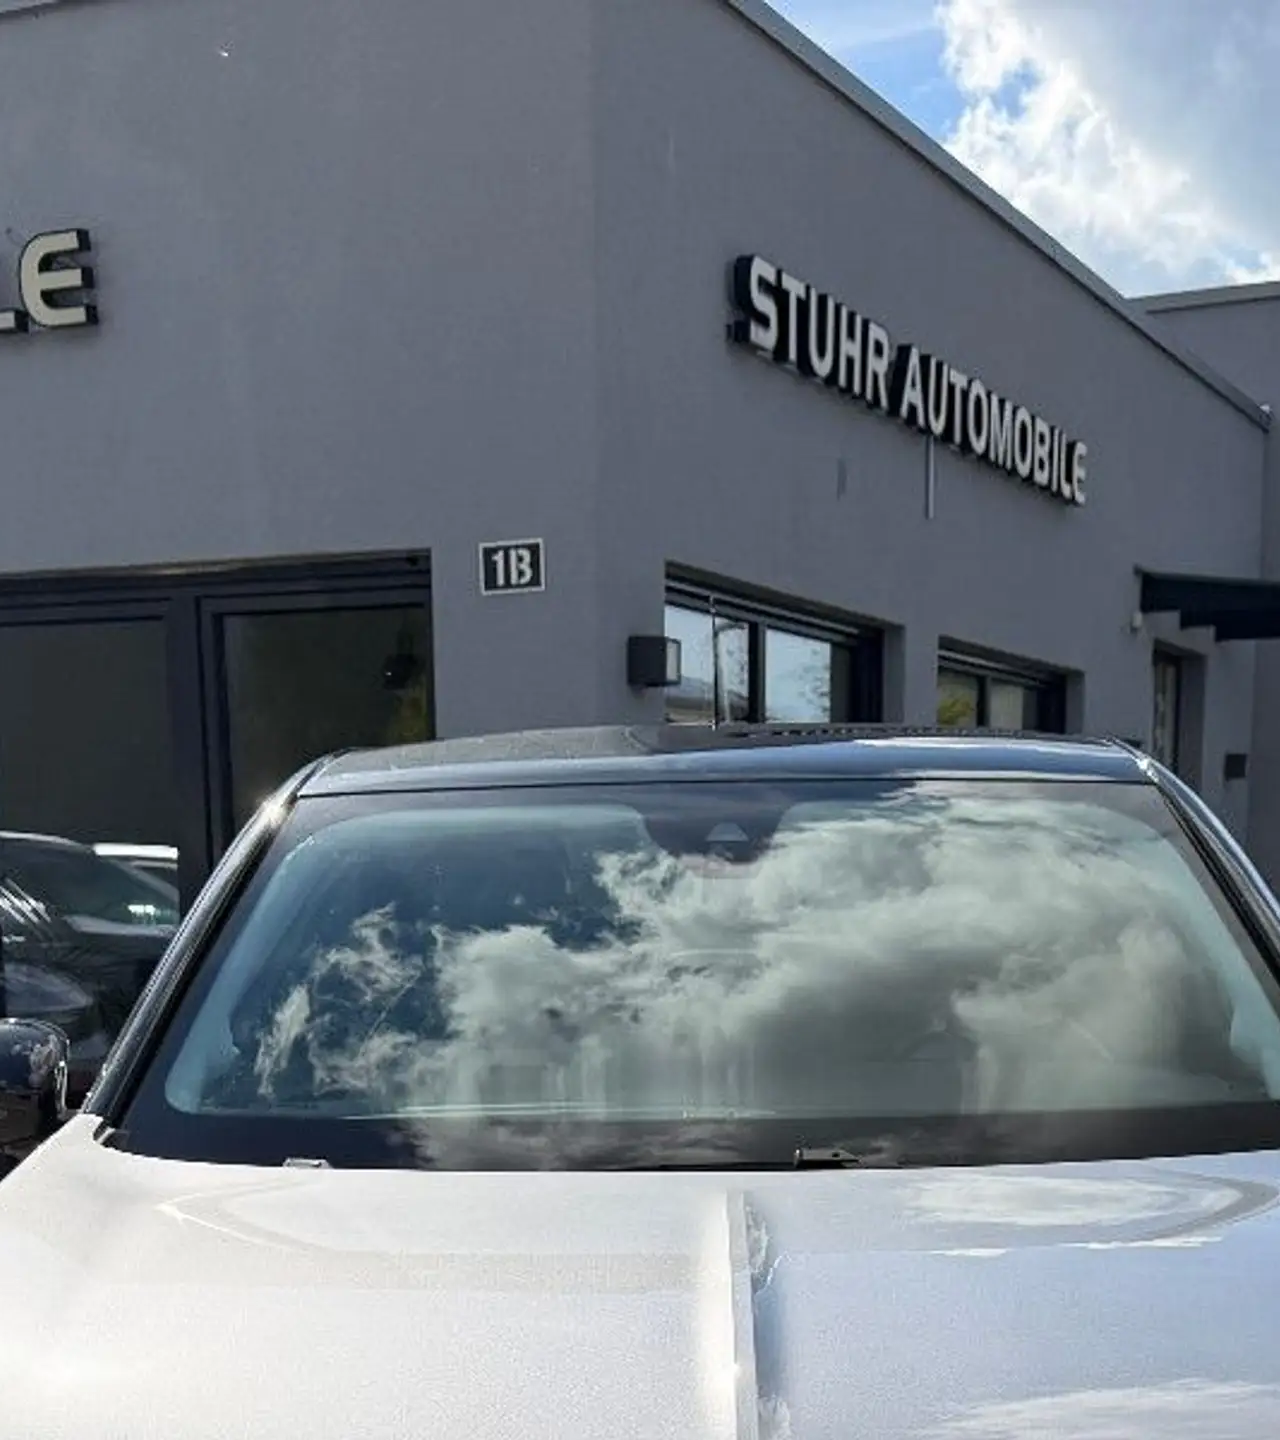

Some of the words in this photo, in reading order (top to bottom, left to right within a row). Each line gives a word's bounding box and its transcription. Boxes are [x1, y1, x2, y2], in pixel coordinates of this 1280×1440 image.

[736, 255, 891, 416] STUHR
[896, 343, 1089, 505] AUTOMOBILE
[491, 547, 533, 587] 1B
